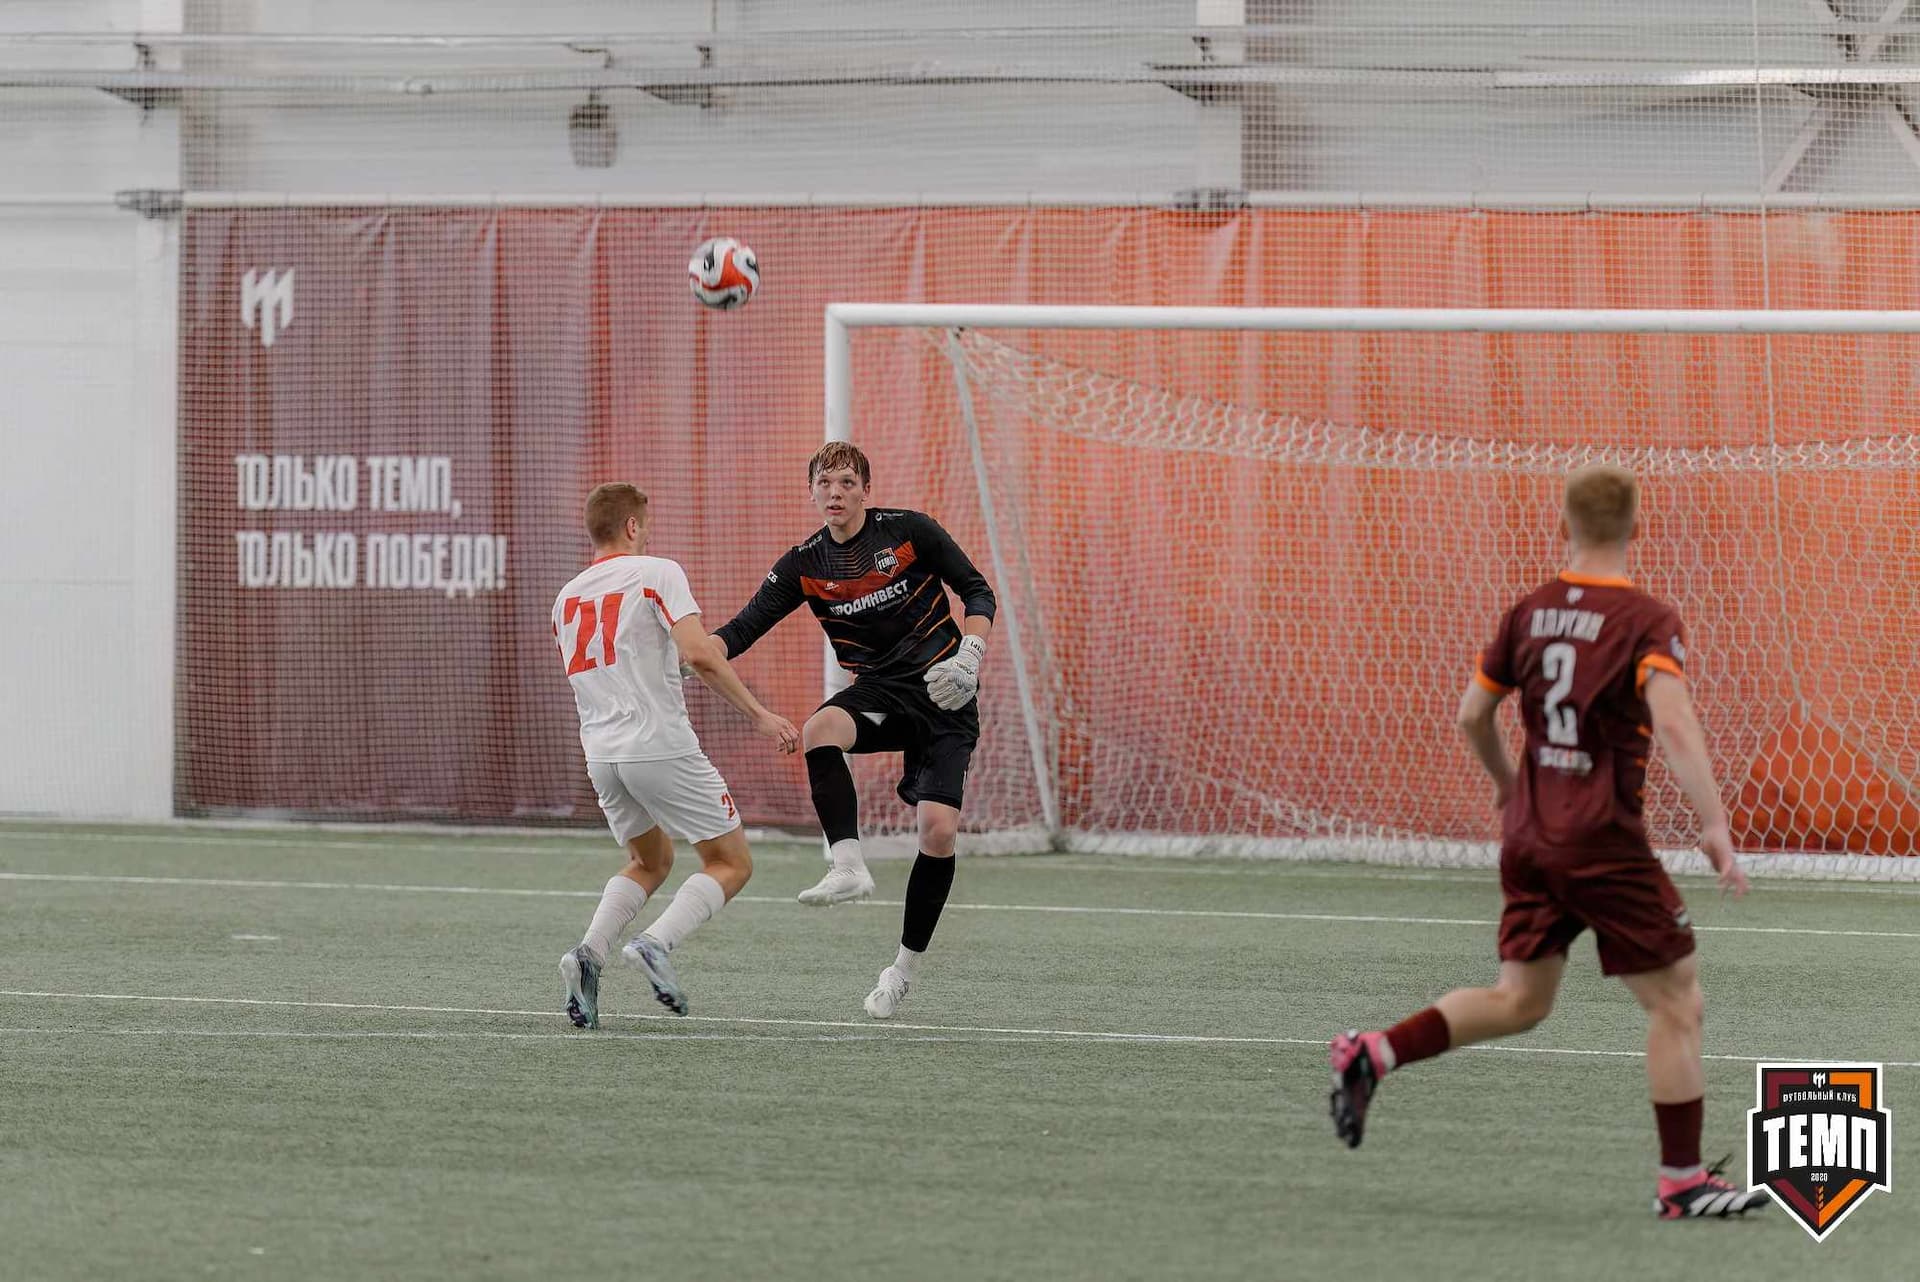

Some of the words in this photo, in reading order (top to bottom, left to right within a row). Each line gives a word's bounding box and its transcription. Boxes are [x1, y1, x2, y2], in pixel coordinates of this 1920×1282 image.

[235, 454, 358, 512] ТОЛЬКО
[367, 456, 462, 519] ТЕМП,
[235, 530, 358, 589] ТОЛЬКО
[366, 533, 508, 598] ПОБЕДА!
[563, 592, 625, 677] 21
[1542, 642, 1579, 747] 2
